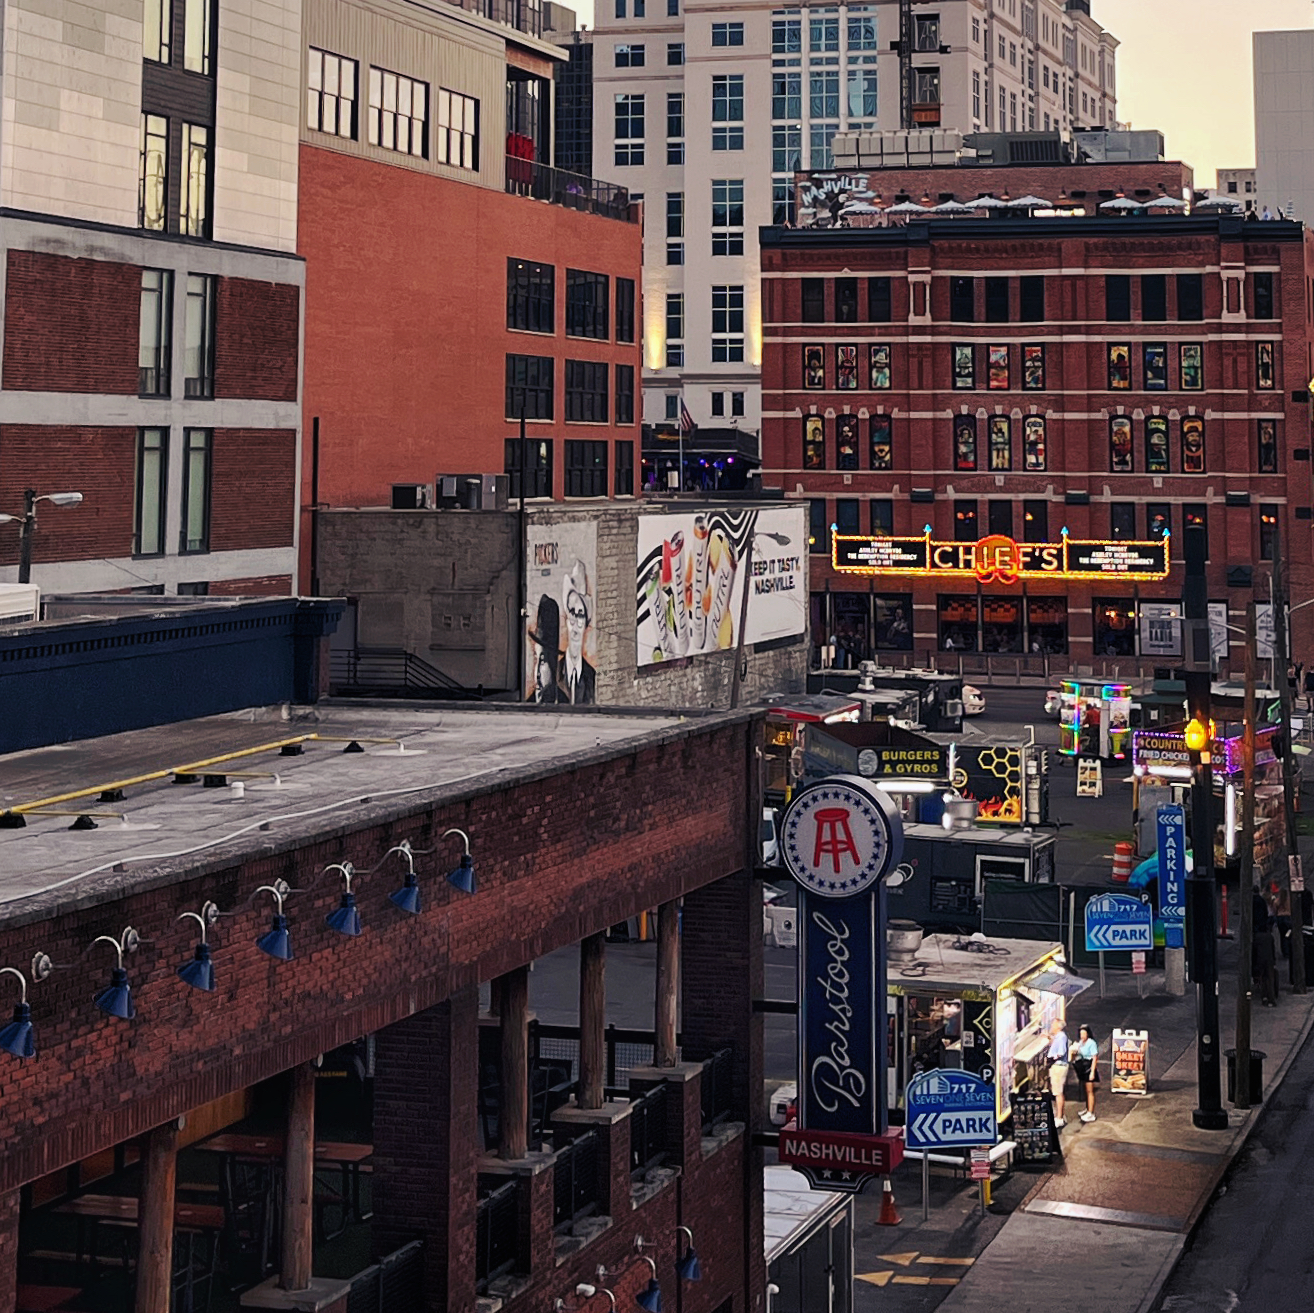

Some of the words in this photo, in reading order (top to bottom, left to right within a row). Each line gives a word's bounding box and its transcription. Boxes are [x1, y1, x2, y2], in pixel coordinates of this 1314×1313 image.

[933, 546, 1058, 571] CHIEF'S
[881, 750, 940, 761] BURGERS
[884, 765, 892, 773] &
[895, 763, 939, 773] GYROS
[1165, 826, 1179, 904] PARKING
[1112, 929, 1148, 941] PARK
[811, 911, 866, 1113] Barstool
[982, 1069, 992, 1081] P
[951, 1083, 976, 1093] 717
[941, 1117, 992, 1135] PARK
[785, 1137, 883, 1167] NASHVILLE
